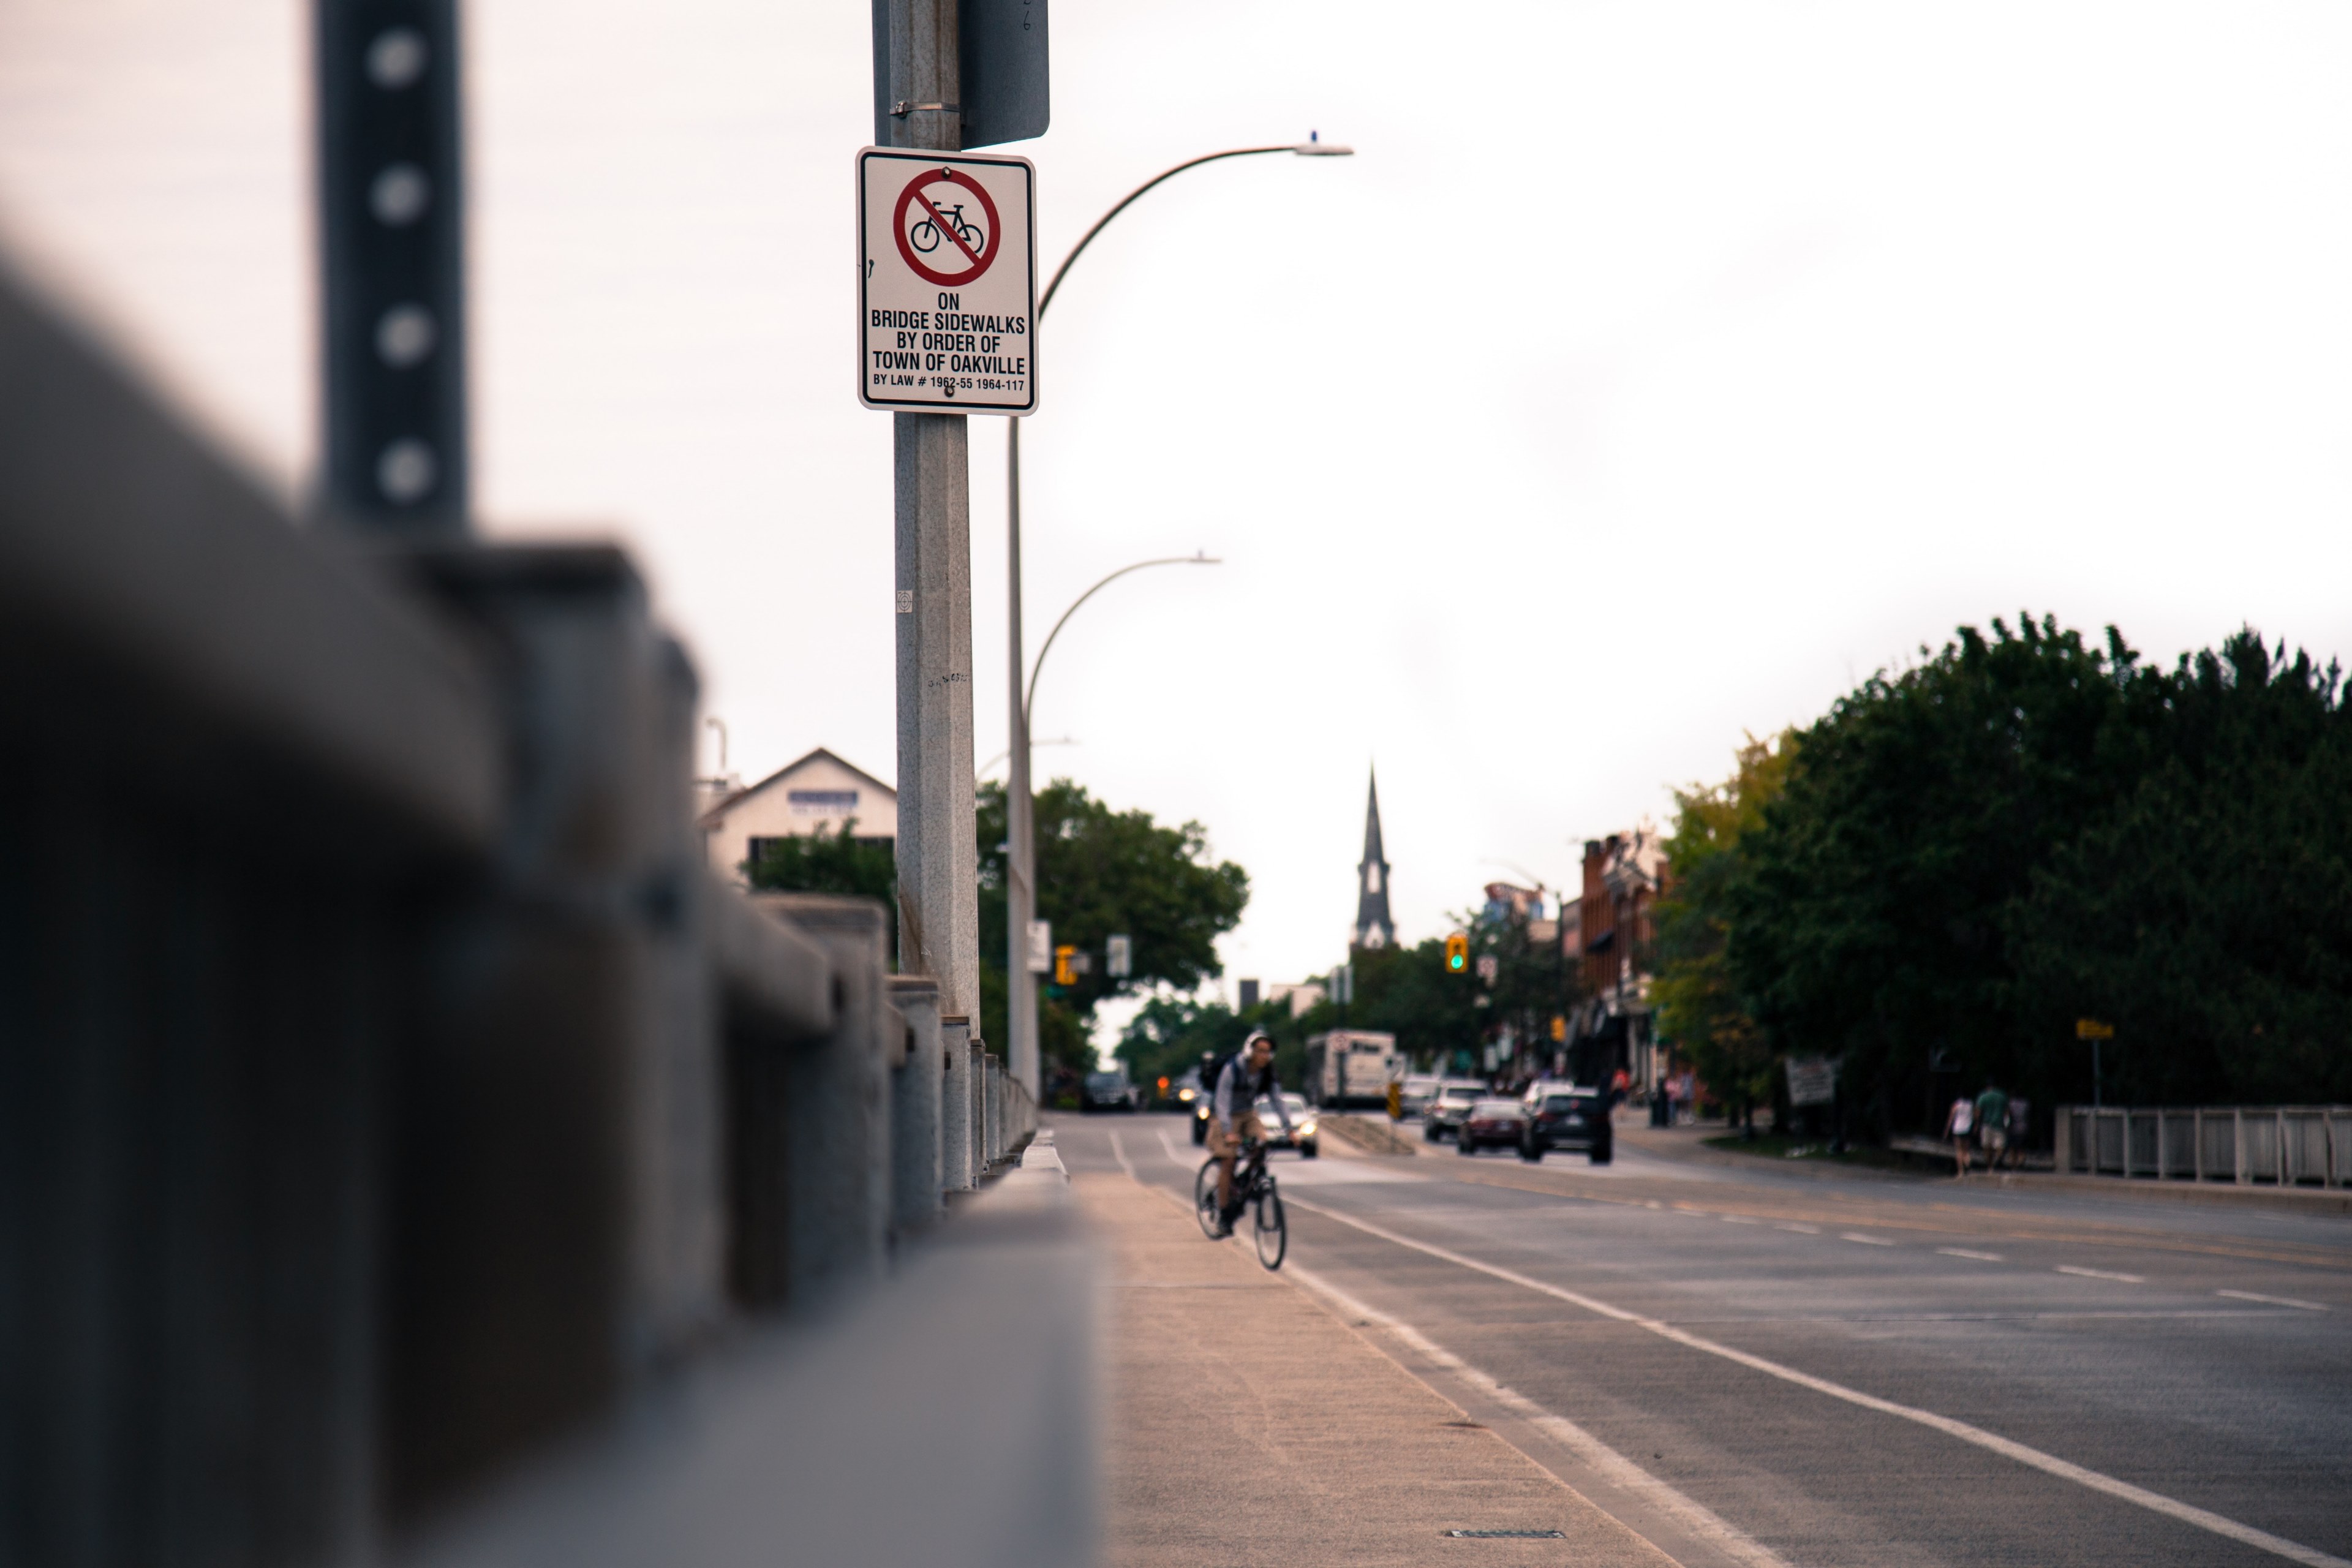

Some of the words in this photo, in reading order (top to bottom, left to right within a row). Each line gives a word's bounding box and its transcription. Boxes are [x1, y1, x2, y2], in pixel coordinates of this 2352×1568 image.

[938, 292, 959, 311] ON
[872, 309, 929, 330] BRIDGE
[935, 312, 1025, 334] SIDEWALKS
[897, 331, 918, 349] BY
[922, 333, 976, 352] ORDER
[981, 335, 1000, 353] OF
[873, 350, 920, 370] TOWN
[925, 353, 945, 371] OF
[951, 354, 1025, 375] OAKVILLE
[873, 374, 888, 385] BY
[891, 374, 914, 386] LAW
[918, 376, 927, 386] #
[930, 376, 973, 389] 1962-55
[976, 379, 1024, 391] 1964-117
